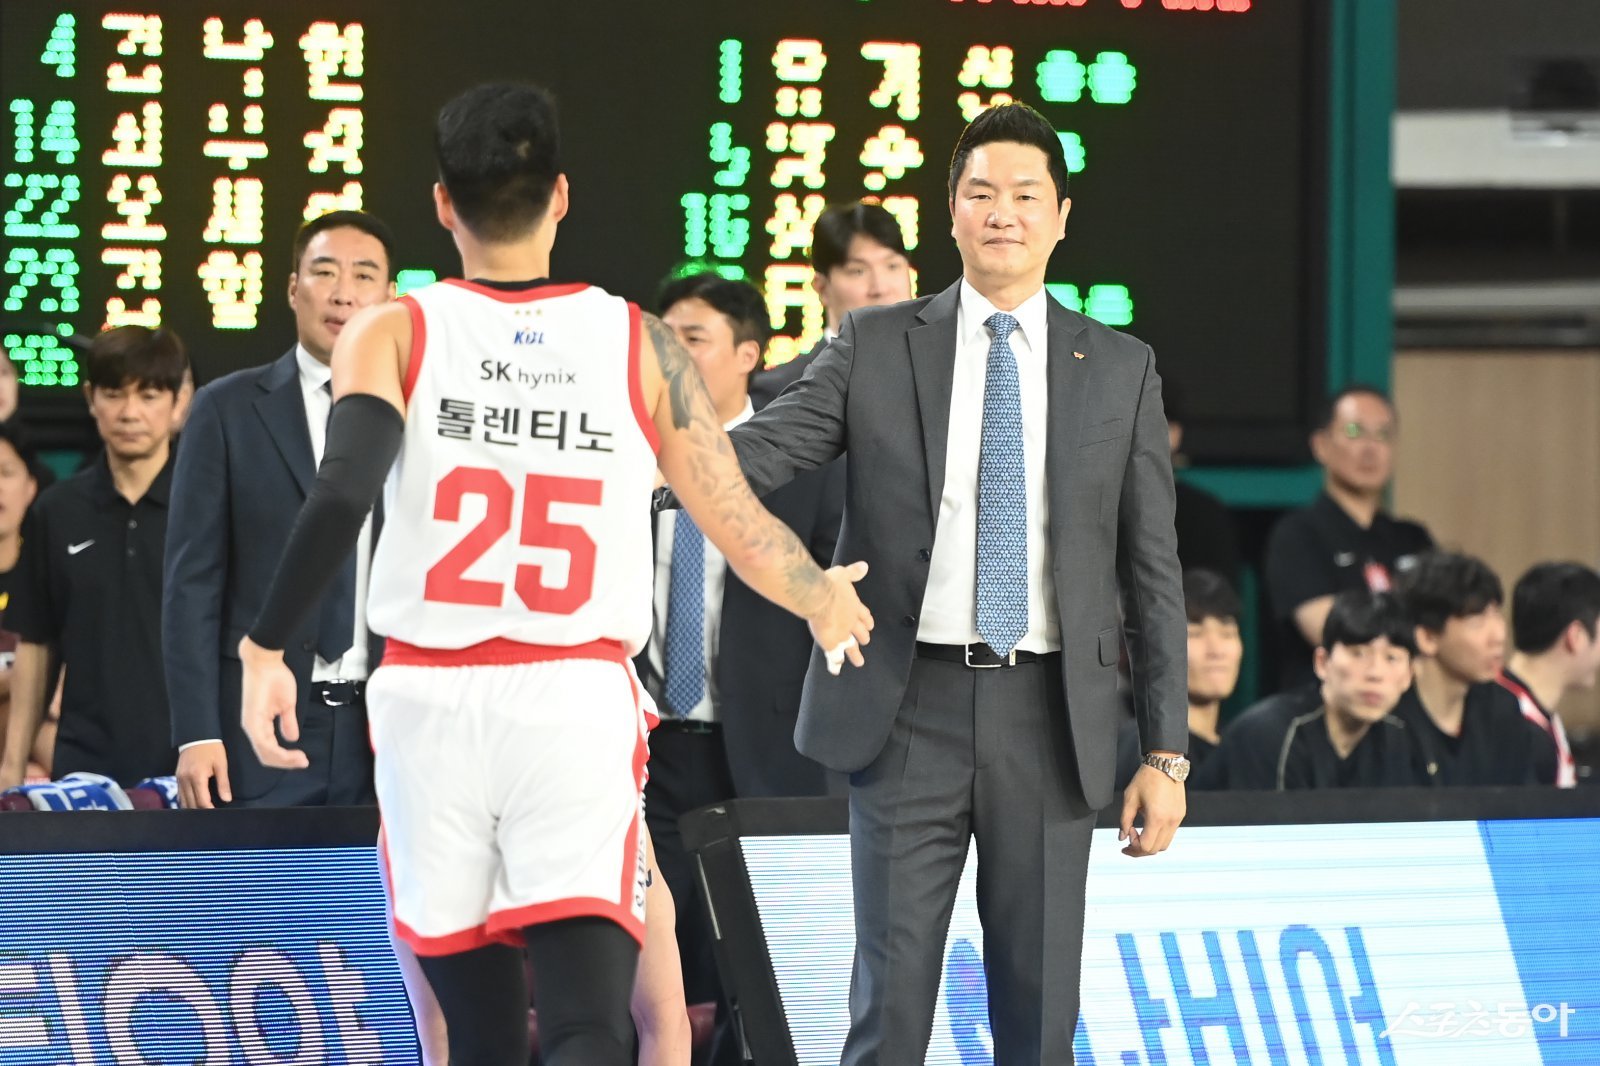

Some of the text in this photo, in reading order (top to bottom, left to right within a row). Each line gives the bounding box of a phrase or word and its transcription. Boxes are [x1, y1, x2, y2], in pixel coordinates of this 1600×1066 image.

[480, 359, 577, 391] SK hynix
[437, 397, 614, 453] 톨렌티노
[424, 466, 603, 615] 25
